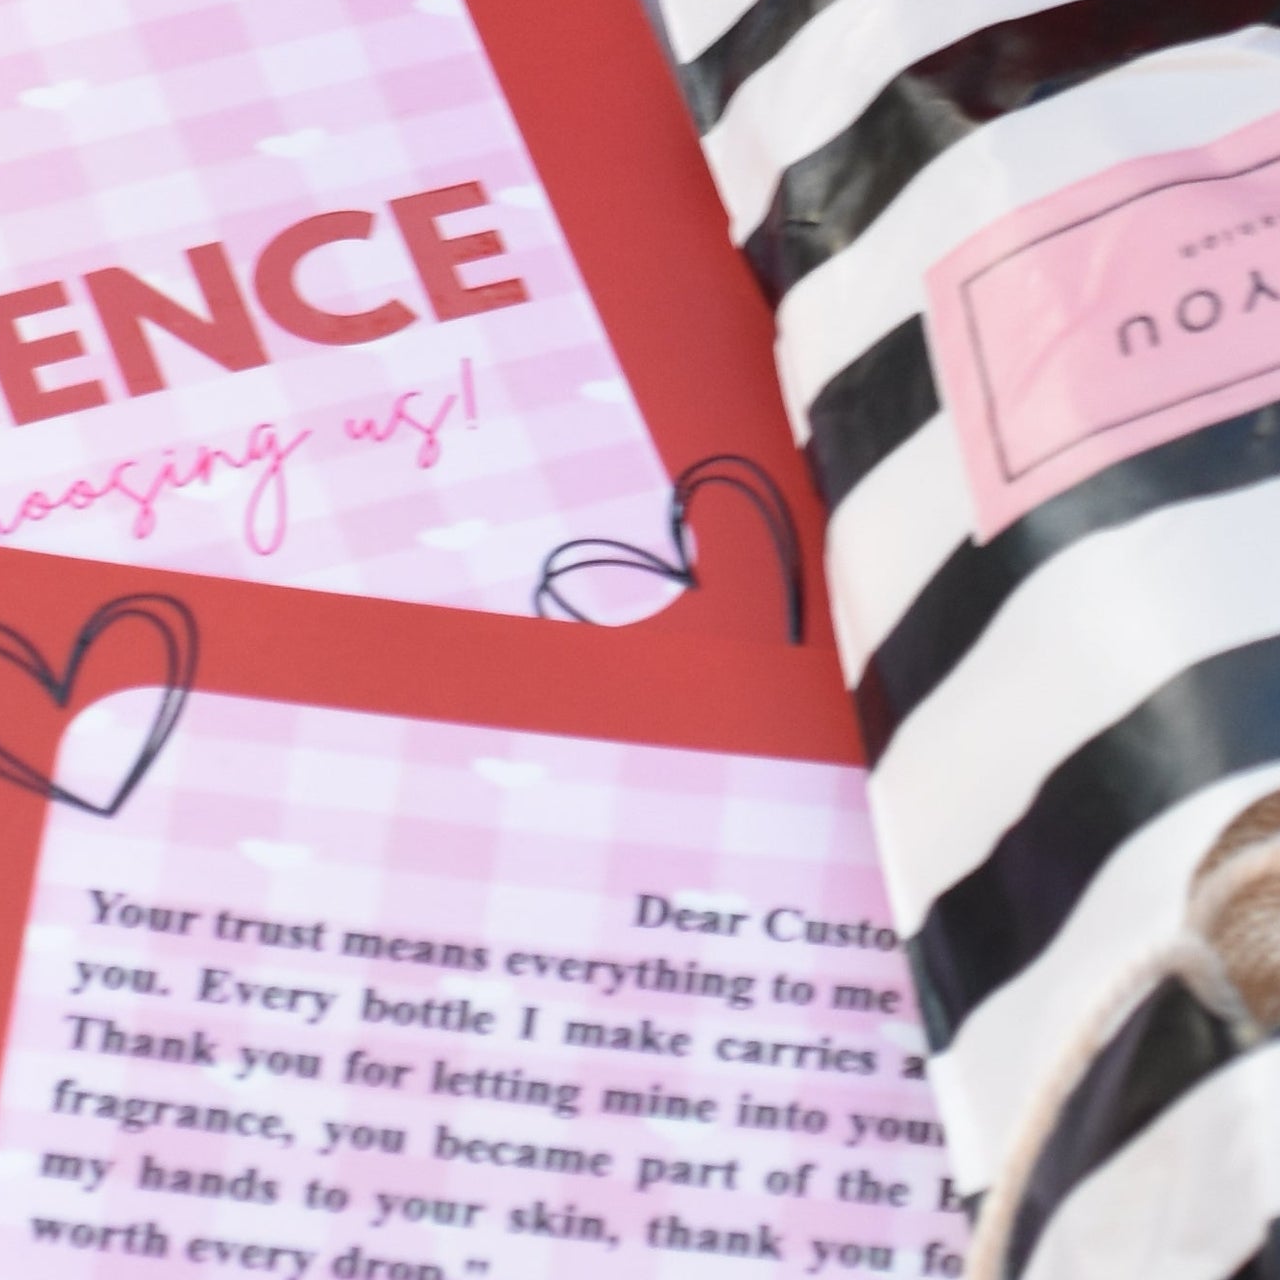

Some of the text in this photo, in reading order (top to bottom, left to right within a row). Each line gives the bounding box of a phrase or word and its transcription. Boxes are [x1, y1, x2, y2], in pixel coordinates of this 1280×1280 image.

[344, 358, 479, 470] us!
[87, 888, 901, 1015] Your trust means everything to me
[634, 892, 901, 951] Dear Custo
[65, 1014, 220, 1067] Thank
[238, 1042, 322, 1080] you
[343, 1050, 414, 1089] for
[430, 1058, 582, 1121] letting
[602, 1083, 718, 1124] mine
[736, 1093, 830, 1135] into
[69, 959, 170, 997] you.
[195, 966, 338, 1025] Every
[361, 987, 497, 1036] bottle
[520, 1005, 539, 1042] I
[564, 1018, 694, 1058] make
[715, 1037, 879, 1076] carries
[51, 1078, 295, 1149] fragrance,
[319, 1120, 407, 1155] you
[434, 1125, 613, 1178] became
[636, 1156, 740, 1194] part
[764, 1163, 817, 1199] of
[835, 1169, 911, 1208] the
[30, 1216, 169, 1259] worth
[186, 1237, 317, 1280] every
[41, 1151, 968, 1277] my hands to your skin, thank you fo
